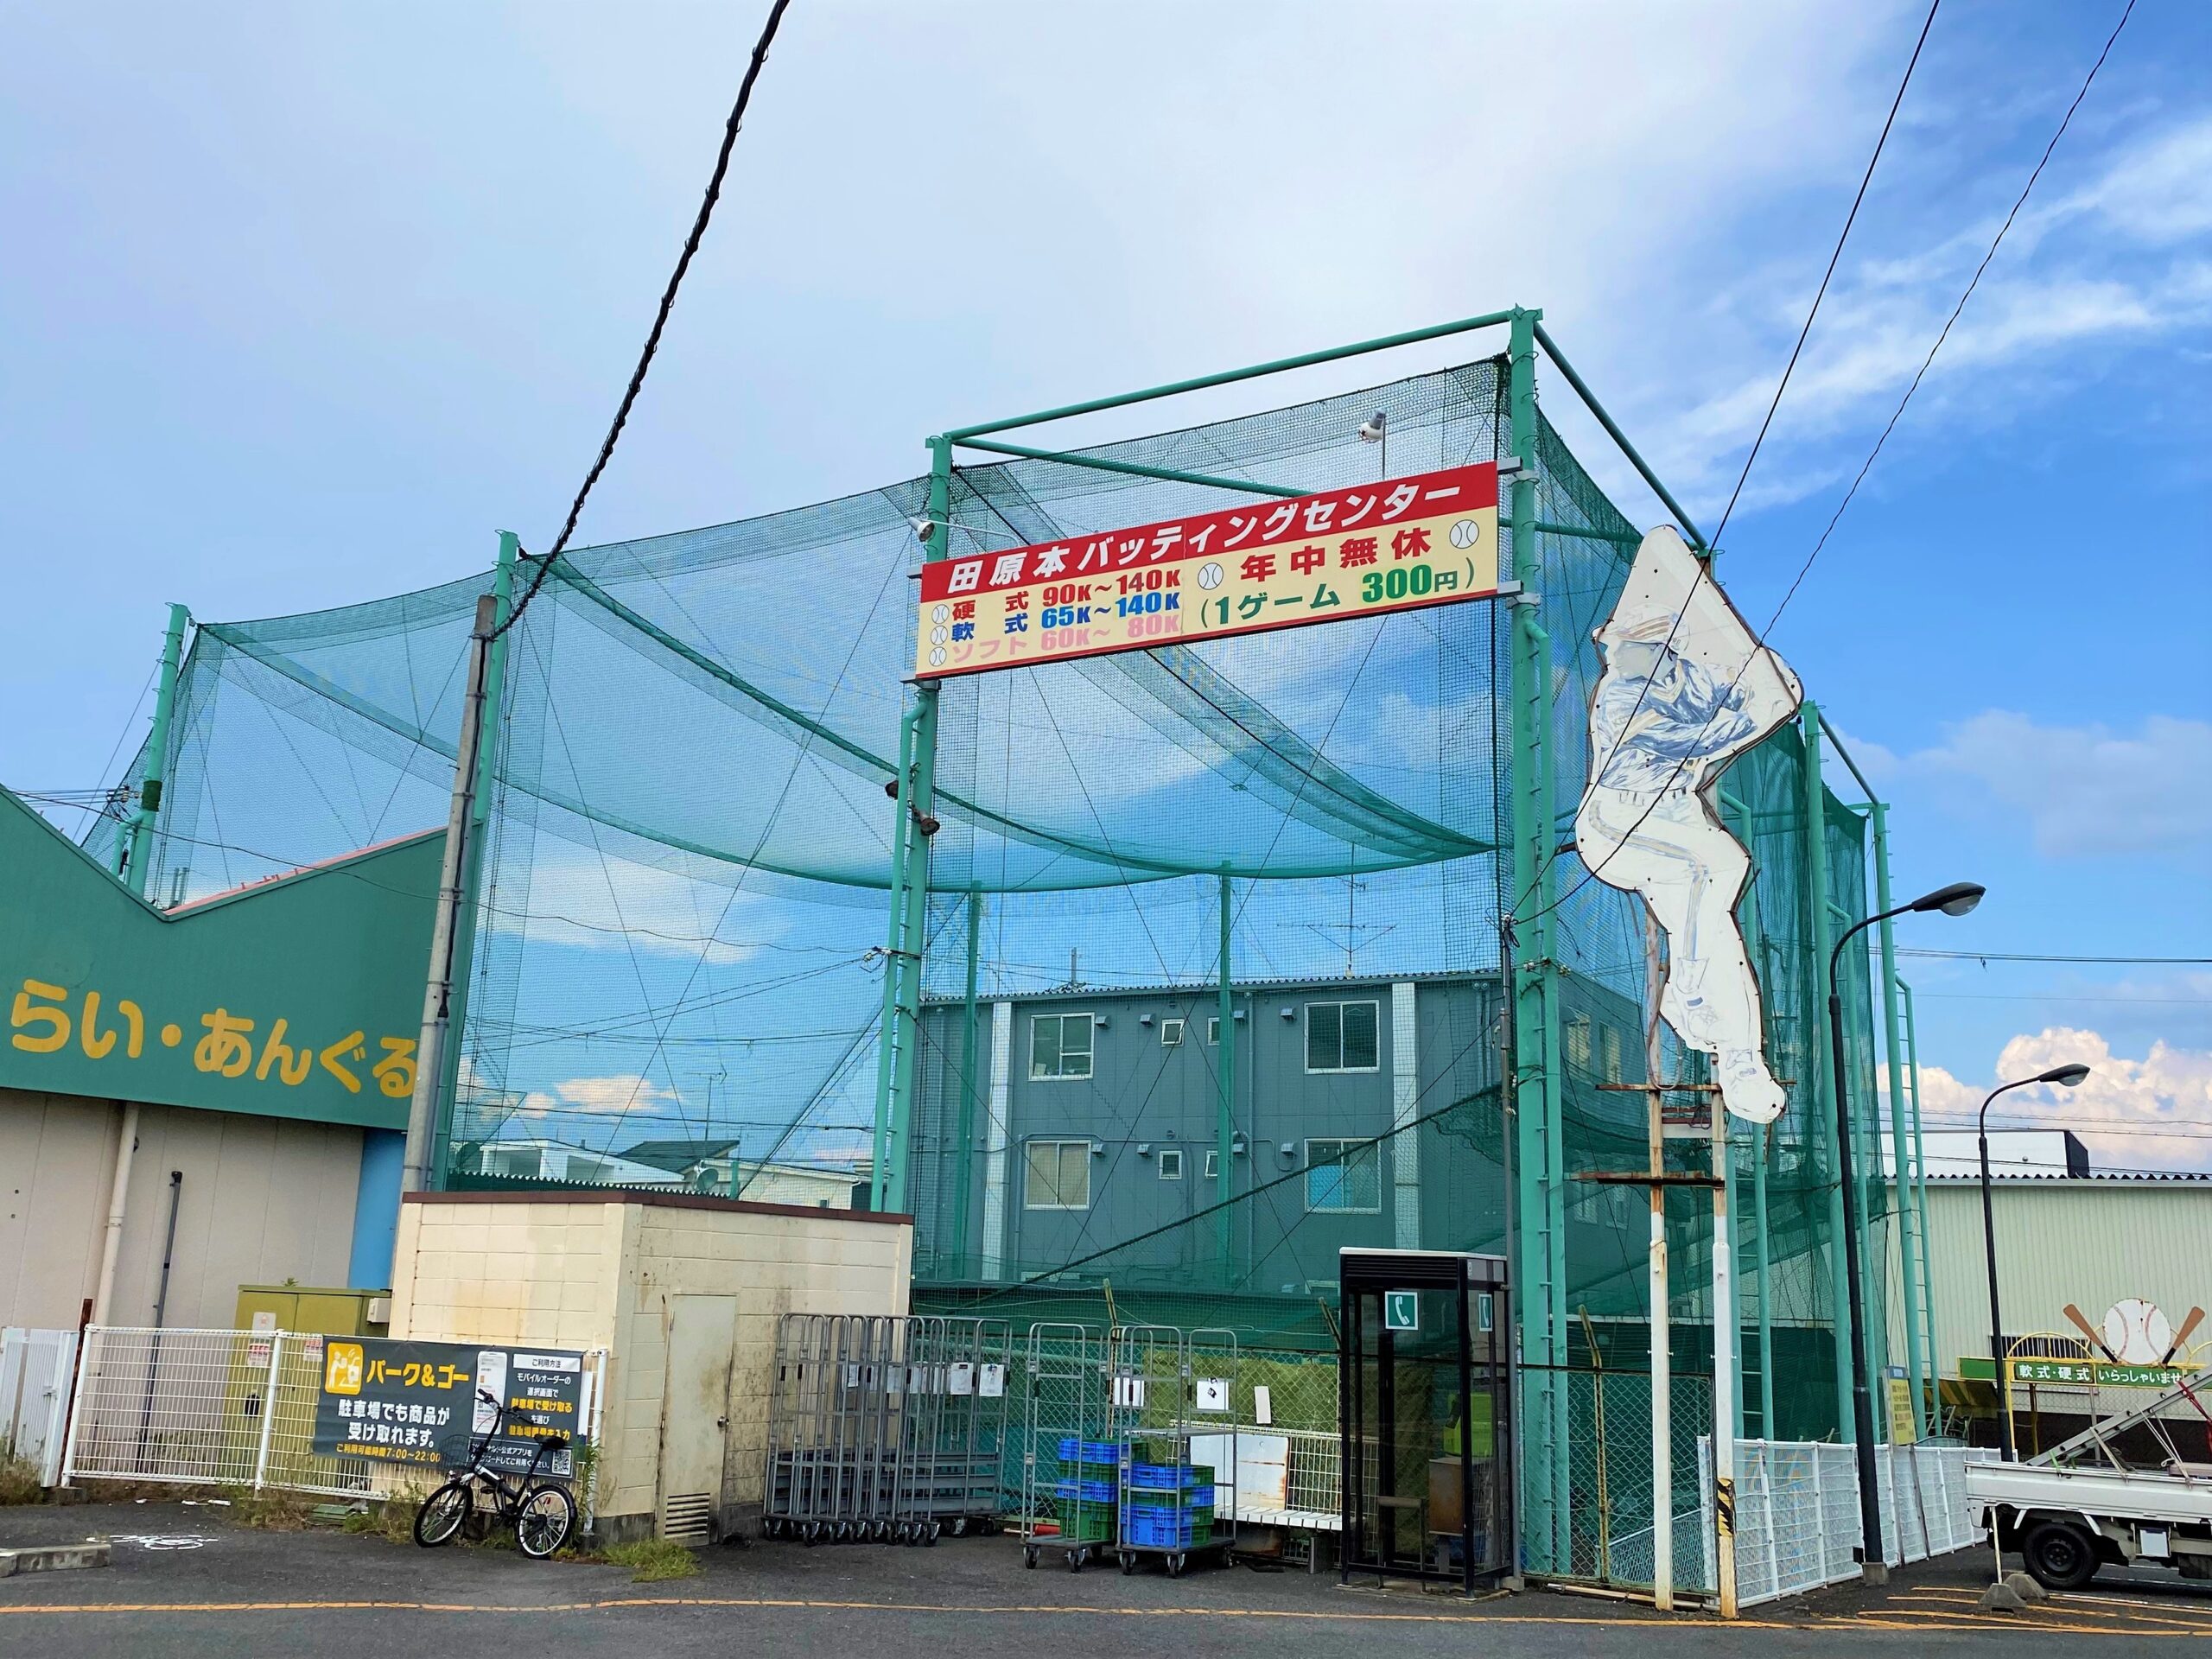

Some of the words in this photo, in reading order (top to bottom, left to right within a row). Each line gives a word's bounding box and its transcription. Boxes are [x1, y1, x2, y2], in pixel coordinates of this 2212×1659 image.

[948, 484, 1461, 594] 田原本バッティングセンター
[1241, 528, 1432, 582] 年中無休
[953, 636, 1027, 664] ソフト
[366, 1360, 469, 1389] パーク&ゴー
[517, 1372, 571, 1385] モバイルオーダーの
[2098, 1369, 2183, 1384] いらっしゃいませ
[338, 1398, 449, 1426] 駐車場でも商品が
[347, 1421, 435, 1448] 受け取れます。
